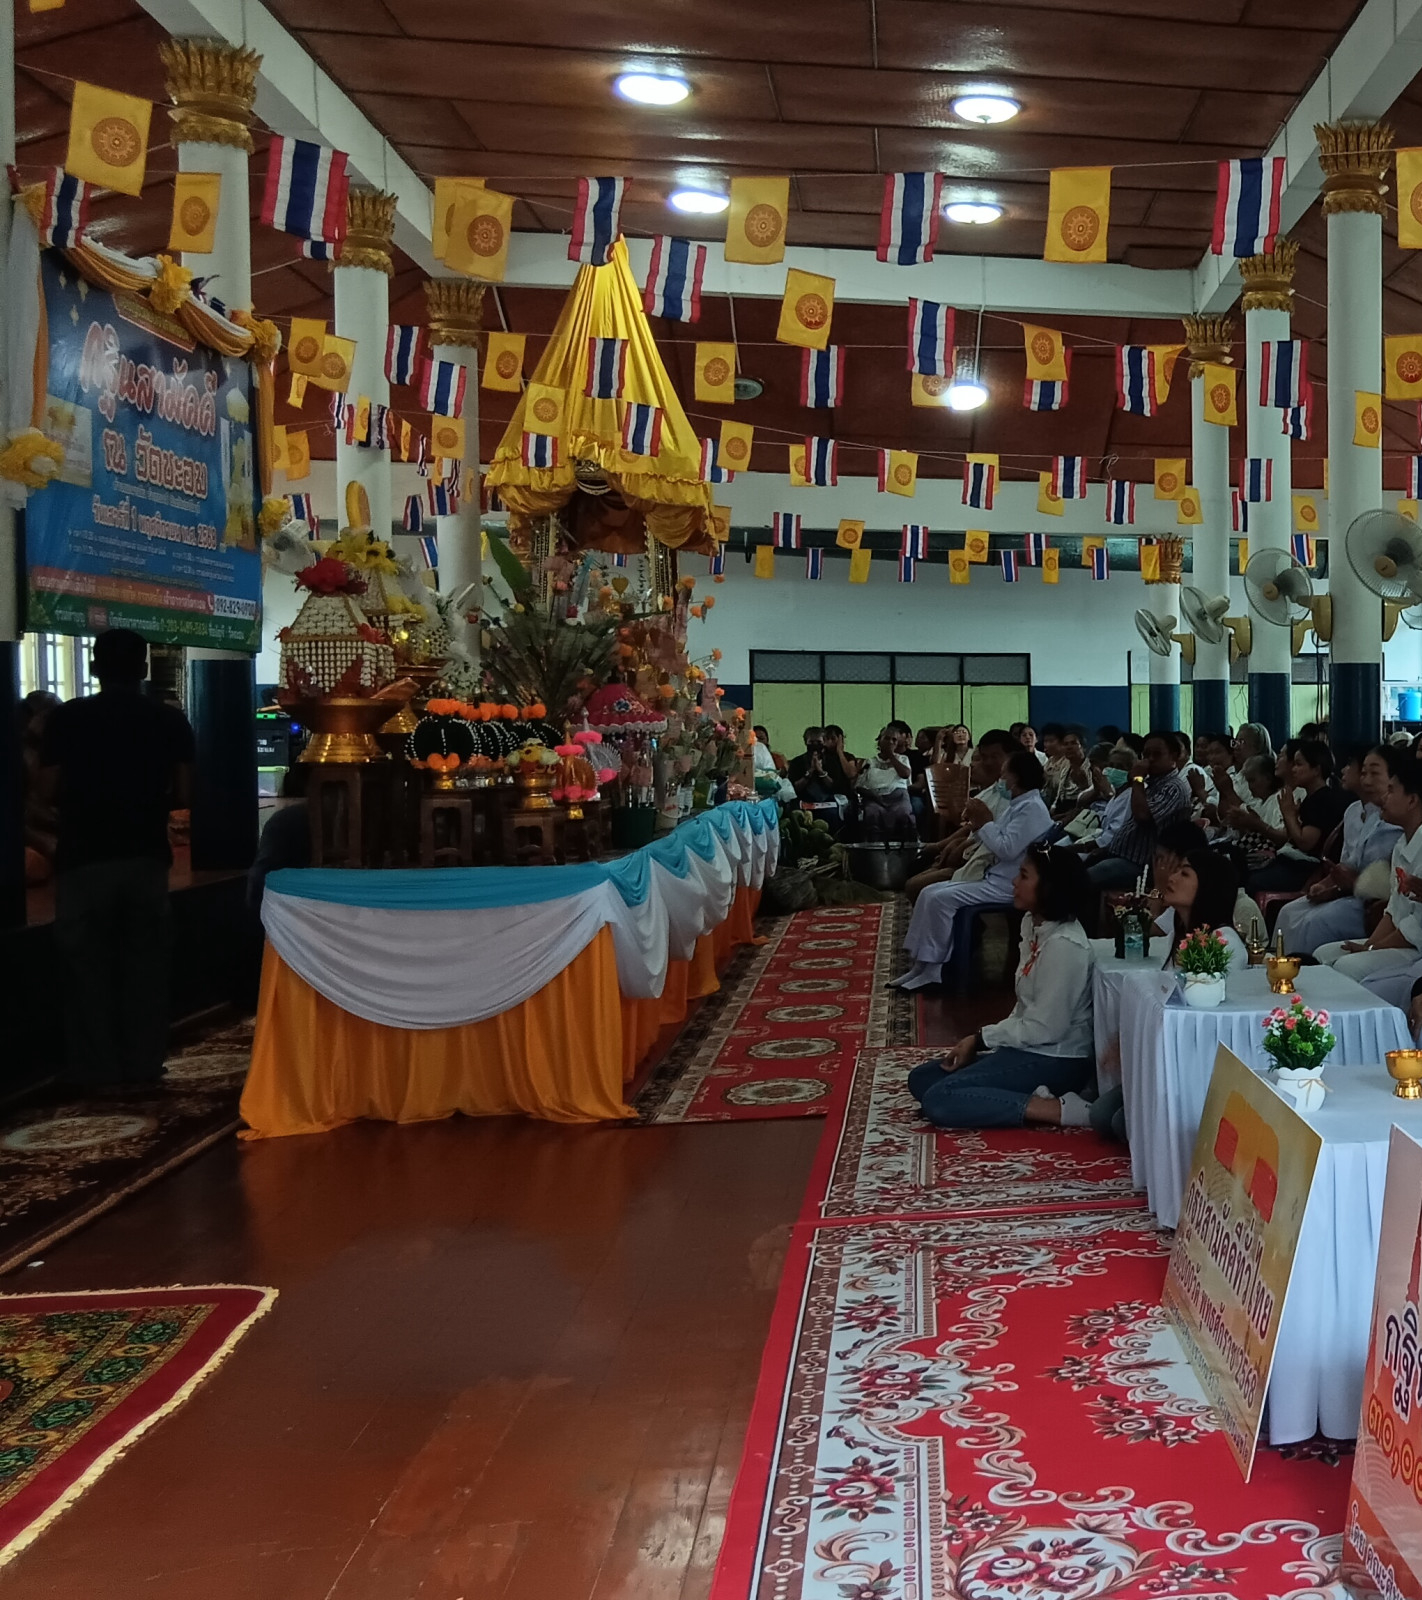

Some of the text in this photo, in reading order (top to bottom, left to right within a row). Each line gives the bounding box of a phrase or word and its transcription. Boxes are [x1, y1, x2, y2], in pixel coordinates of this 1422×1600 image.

[80, 320, 218, 437] กฐินสามัคคี
[102, 428, 127, 475] ณ
[135, 424, 209, 499] วัดชะอม
[1185, 1169, 1274, 1340] กฐินสามัคคีทั่วไทย
[1350, 1502, 1366, 1559] โดย
